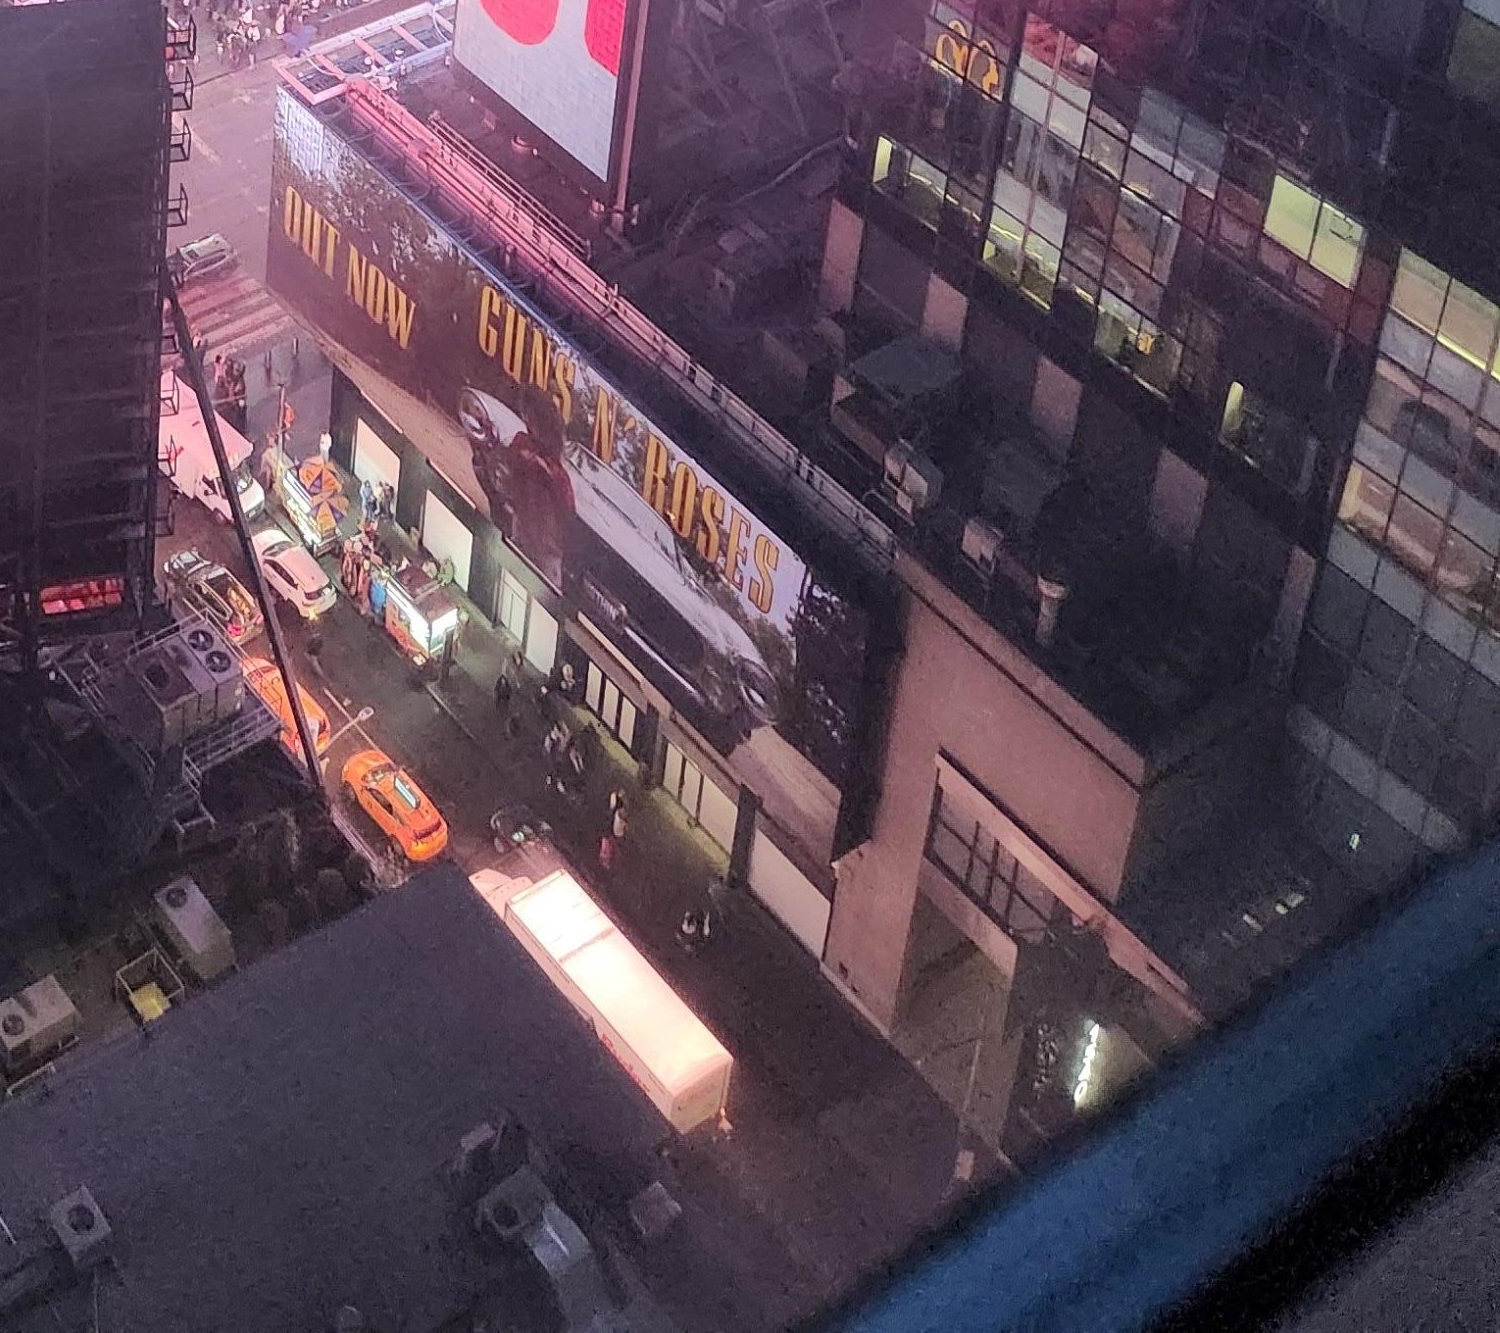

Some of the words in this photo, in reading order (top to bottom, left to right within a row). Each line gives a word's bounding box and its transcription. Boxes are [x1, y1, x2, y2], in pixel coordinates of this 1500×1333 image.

[284, 185, 341, 281] OUT
[347, 242, 417, 350] NOW
[478, 285, 576, 425] GUNS
[642, 433, 780, 614] ROSES
